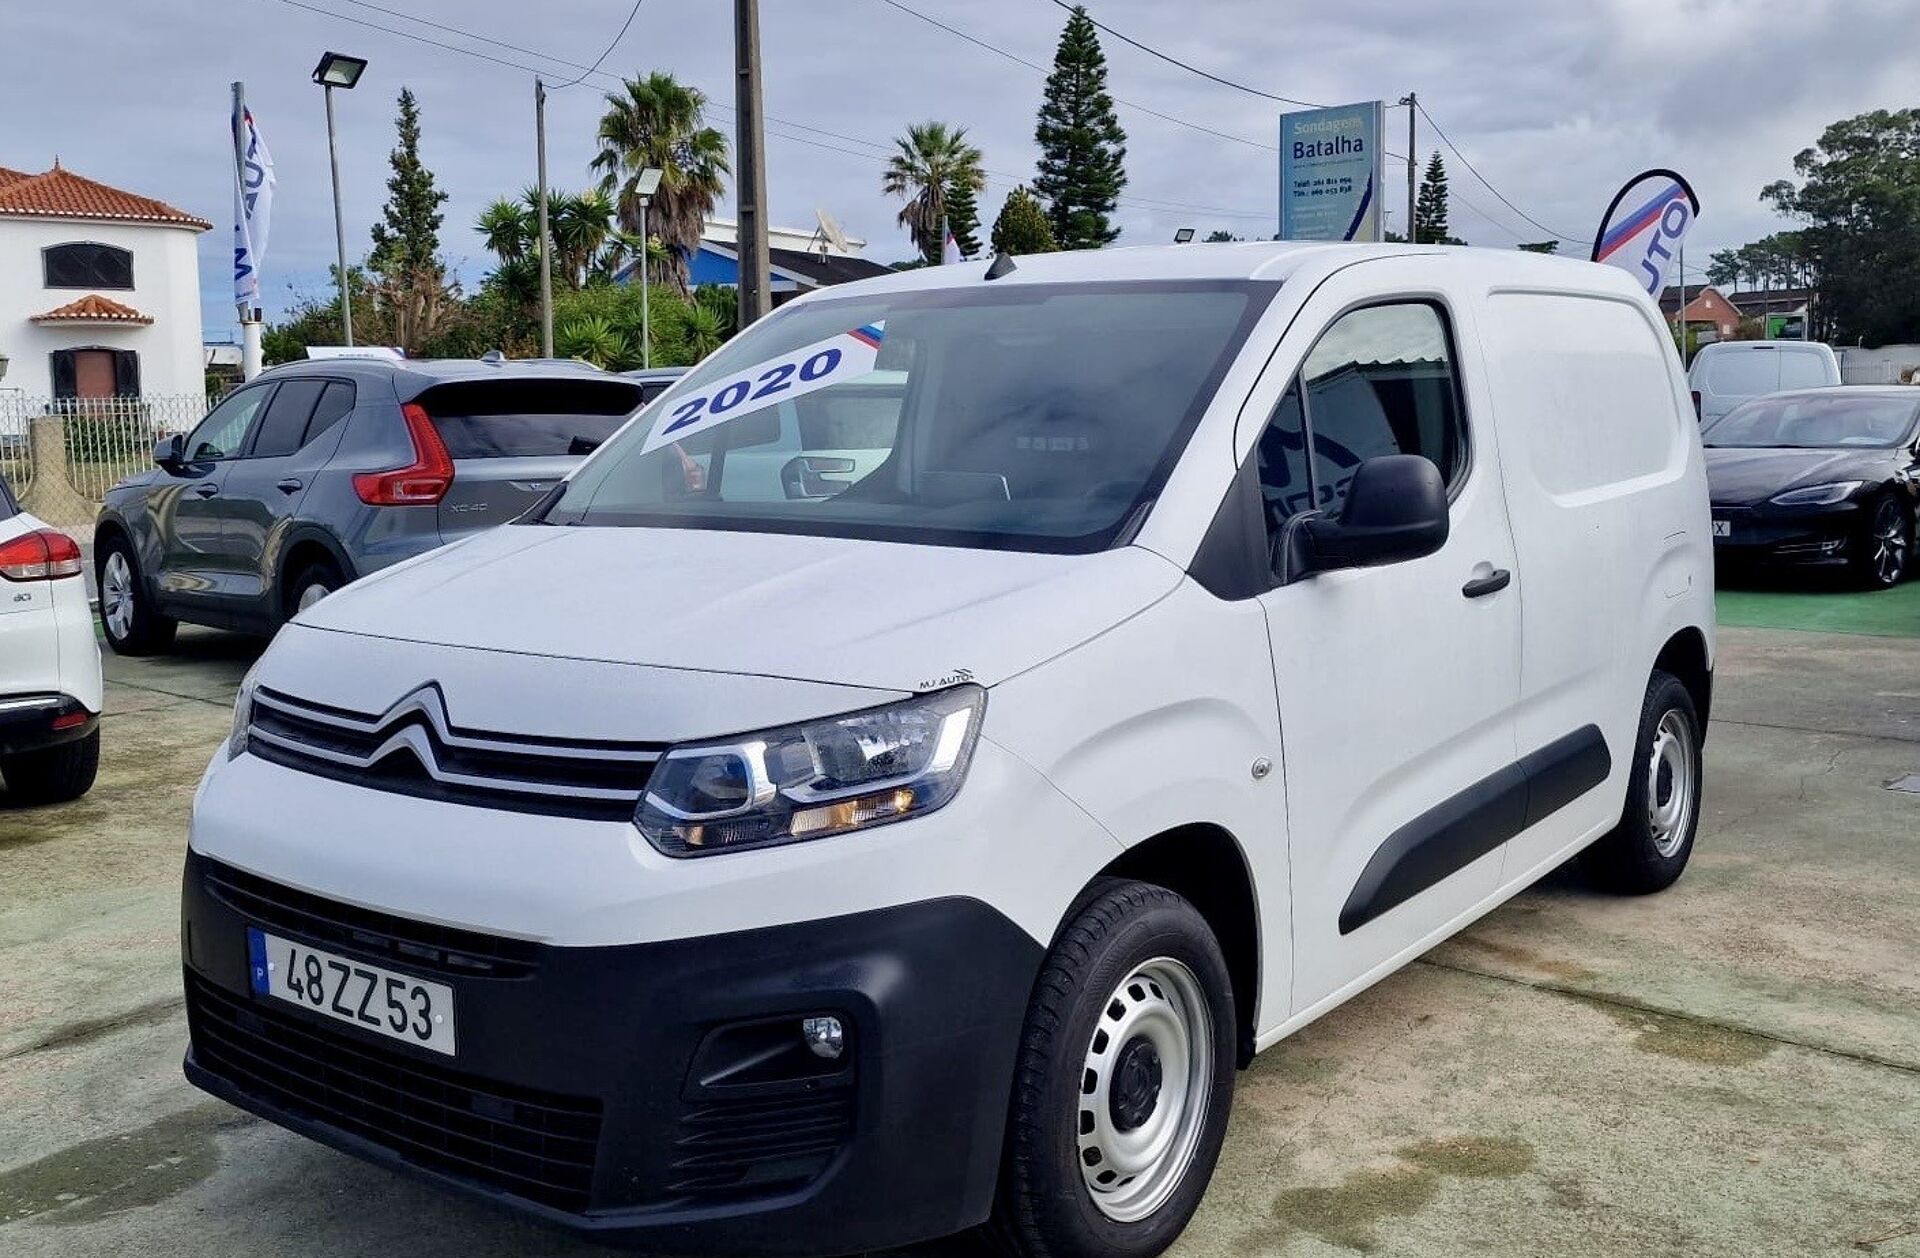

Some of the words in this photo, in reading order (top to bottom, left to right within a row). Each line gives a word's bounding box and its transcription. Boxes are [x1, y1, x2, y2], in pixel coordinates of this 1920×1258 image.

[1293, 135, 1364, 159] Batalha
[661, 348, 843, 436] 2020
[939, 673, 969, 686] AUTO
[286, 948, 432, 1041] 48ZZ53
